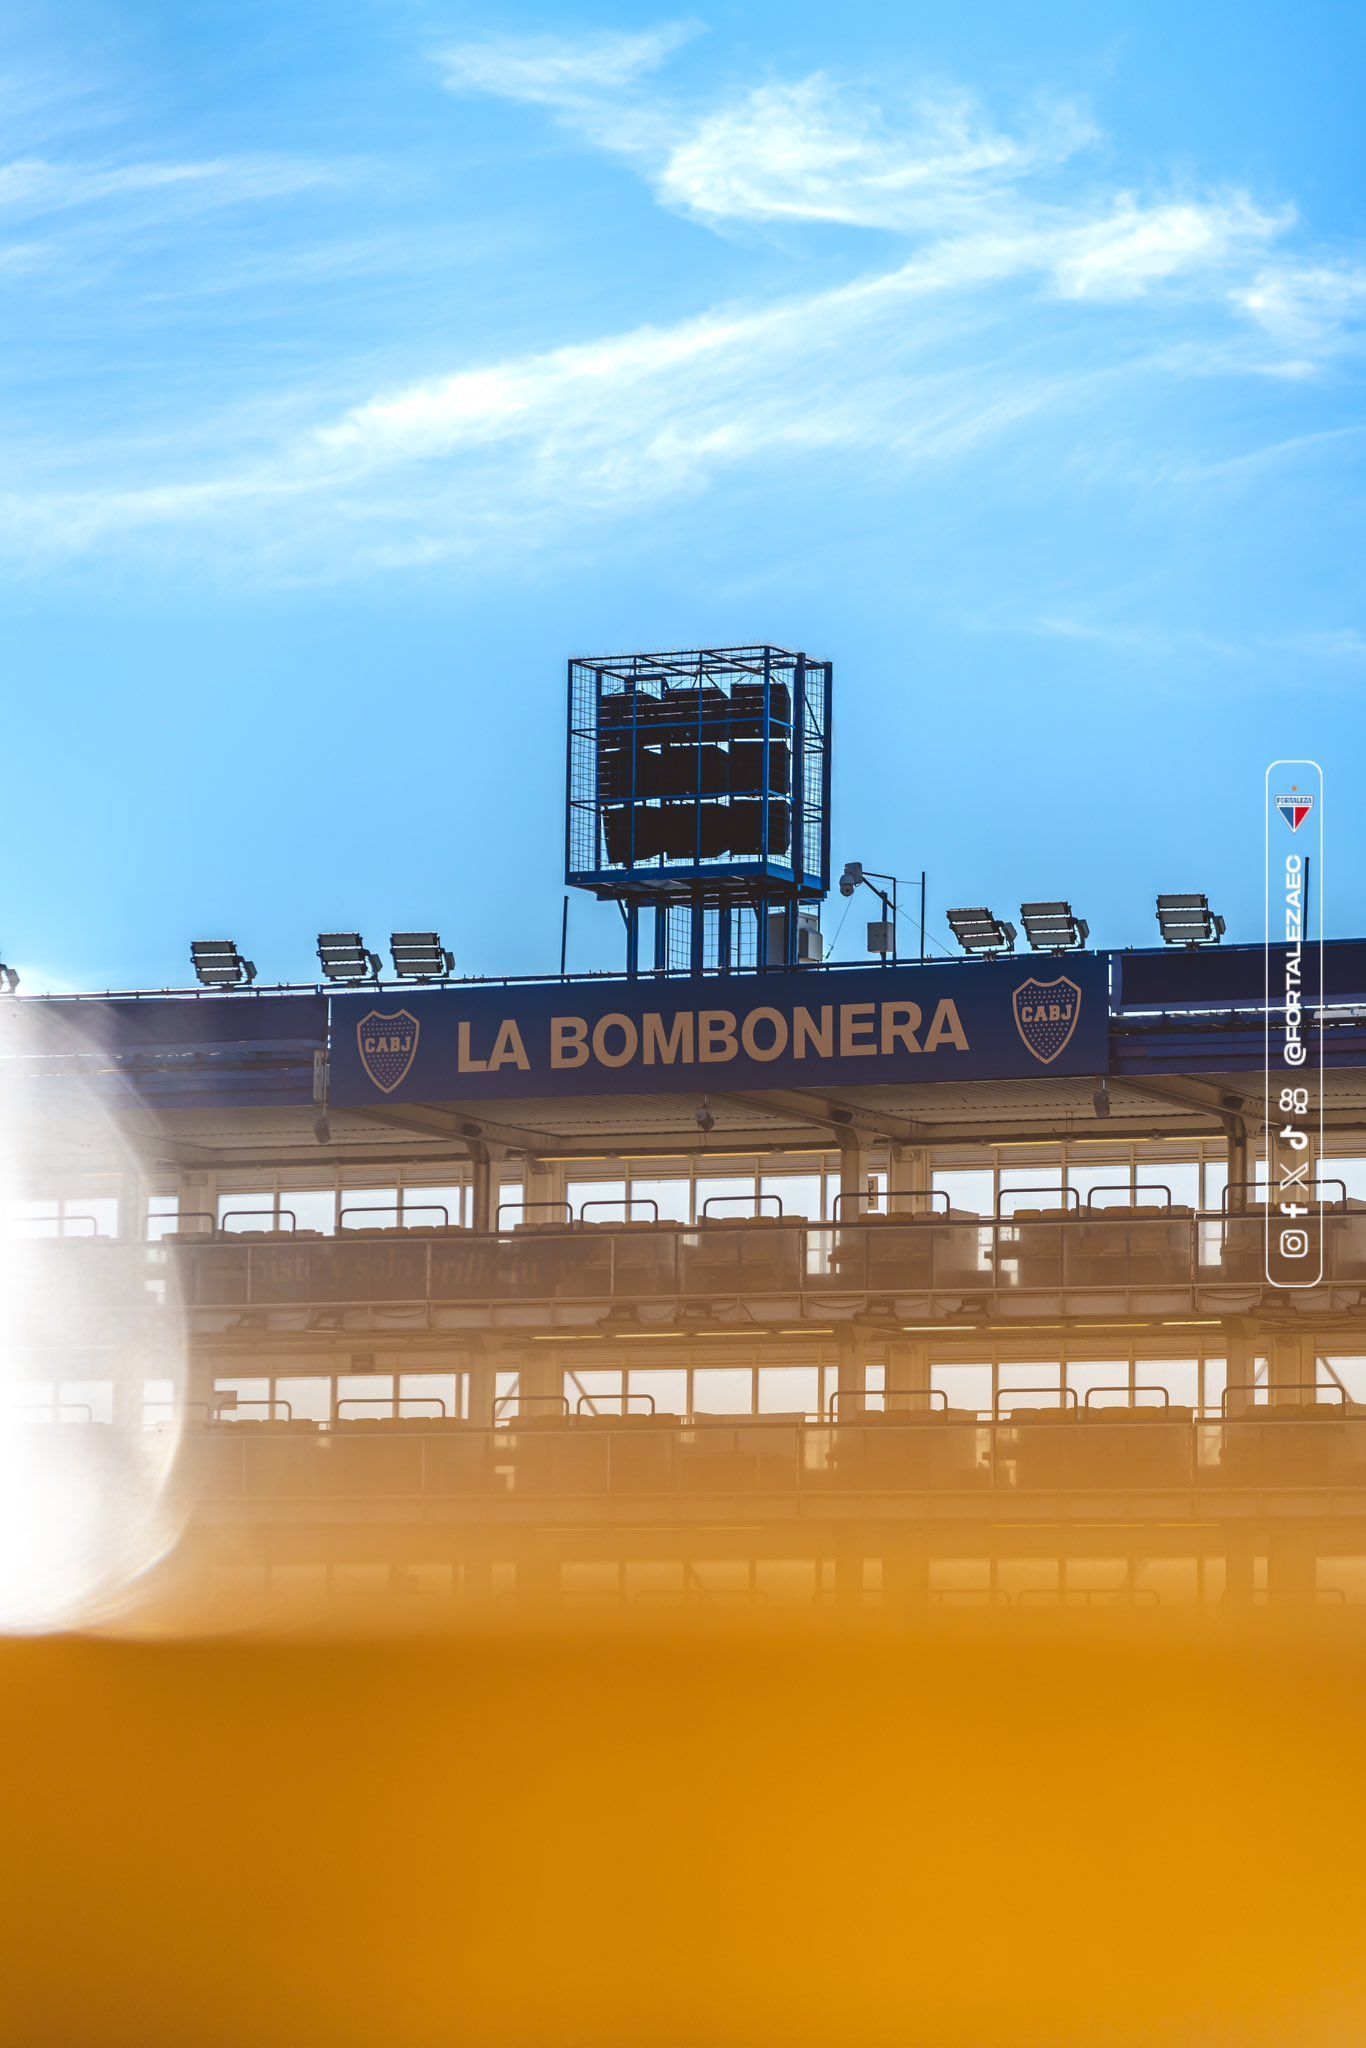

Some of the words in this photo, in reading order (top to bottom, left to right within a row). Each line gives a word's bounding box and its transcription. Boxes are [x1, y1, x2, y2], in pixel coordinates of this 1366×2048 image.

[1021, 1004, 1072, 1023] CABJ
[365, 1036, 411, 1053] CABJ
[457, 1019, 531, 1073] LA
[550, 998, 970, 1069] BOMBONERA
